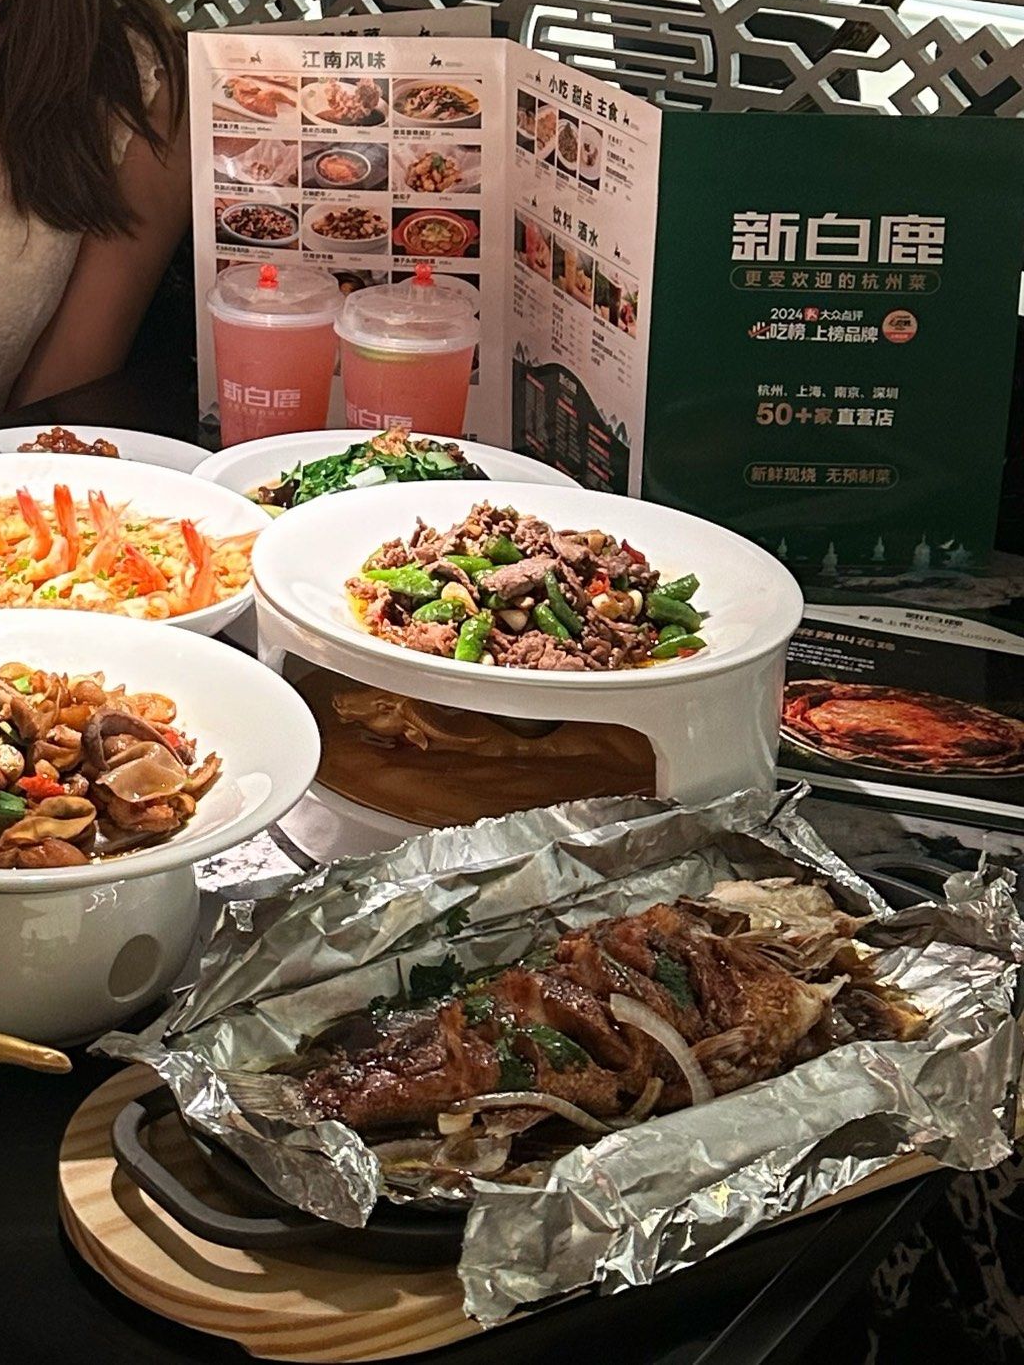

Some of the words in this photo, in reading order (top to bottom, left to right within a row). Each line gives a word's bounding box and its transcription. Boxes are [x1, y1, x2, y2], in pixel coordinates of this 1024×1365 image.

[302, 50, 386, 69] 江南风味
[549, 75, 568, 99] 小吃
[572, 84, 593, 111] 甜点
[597, 97, 618, 123] 主食
[553, 205, 572, 233] 饮料
[578, 220, 600, 247] 酒水
[731, 211, 946, 265] 新白鹿
[745, 270, 926, 291] 更受欢迎的杭州菜
[770, 308, 802, 320] 2024
[819, 309, 864, 321] 大众点评
[811, 325, 878, 343] 上榜品牌
[223, 379, 301, 408] 新白鹿
[756, 402, 833, 426] 50+家
[836, 408, 895, 427] 直营店
[751, 466, 817, 483] 新鲜现烧
[826, 468, 892, 484] 无预制菜
